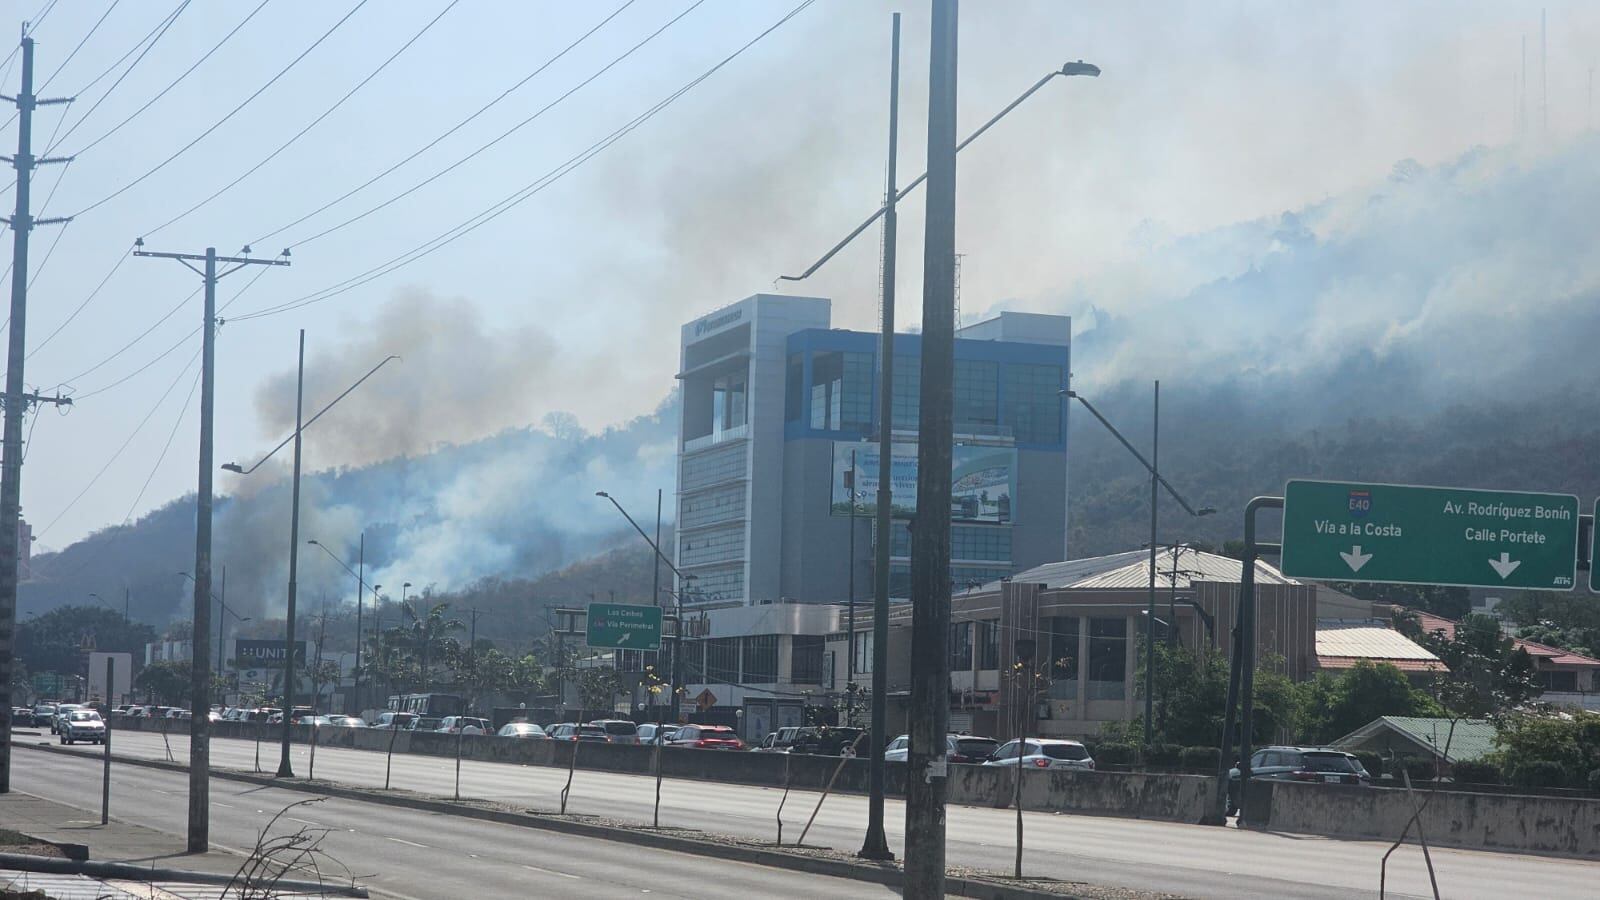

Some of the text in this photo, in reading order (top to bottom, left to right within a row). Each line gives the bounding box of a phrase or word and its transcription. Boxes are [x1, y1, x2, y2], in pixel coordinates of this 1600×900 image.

[1349, 498, 1370, 511] E40
[1443, 501, 1570, 520] Av. Rodríguez Bonín
[1314, 519, 1402, 537] Vía a la Costa
[1465, 527, 1546, 544] Calle Portete
[619, 621, 654, 630] Perimetral
